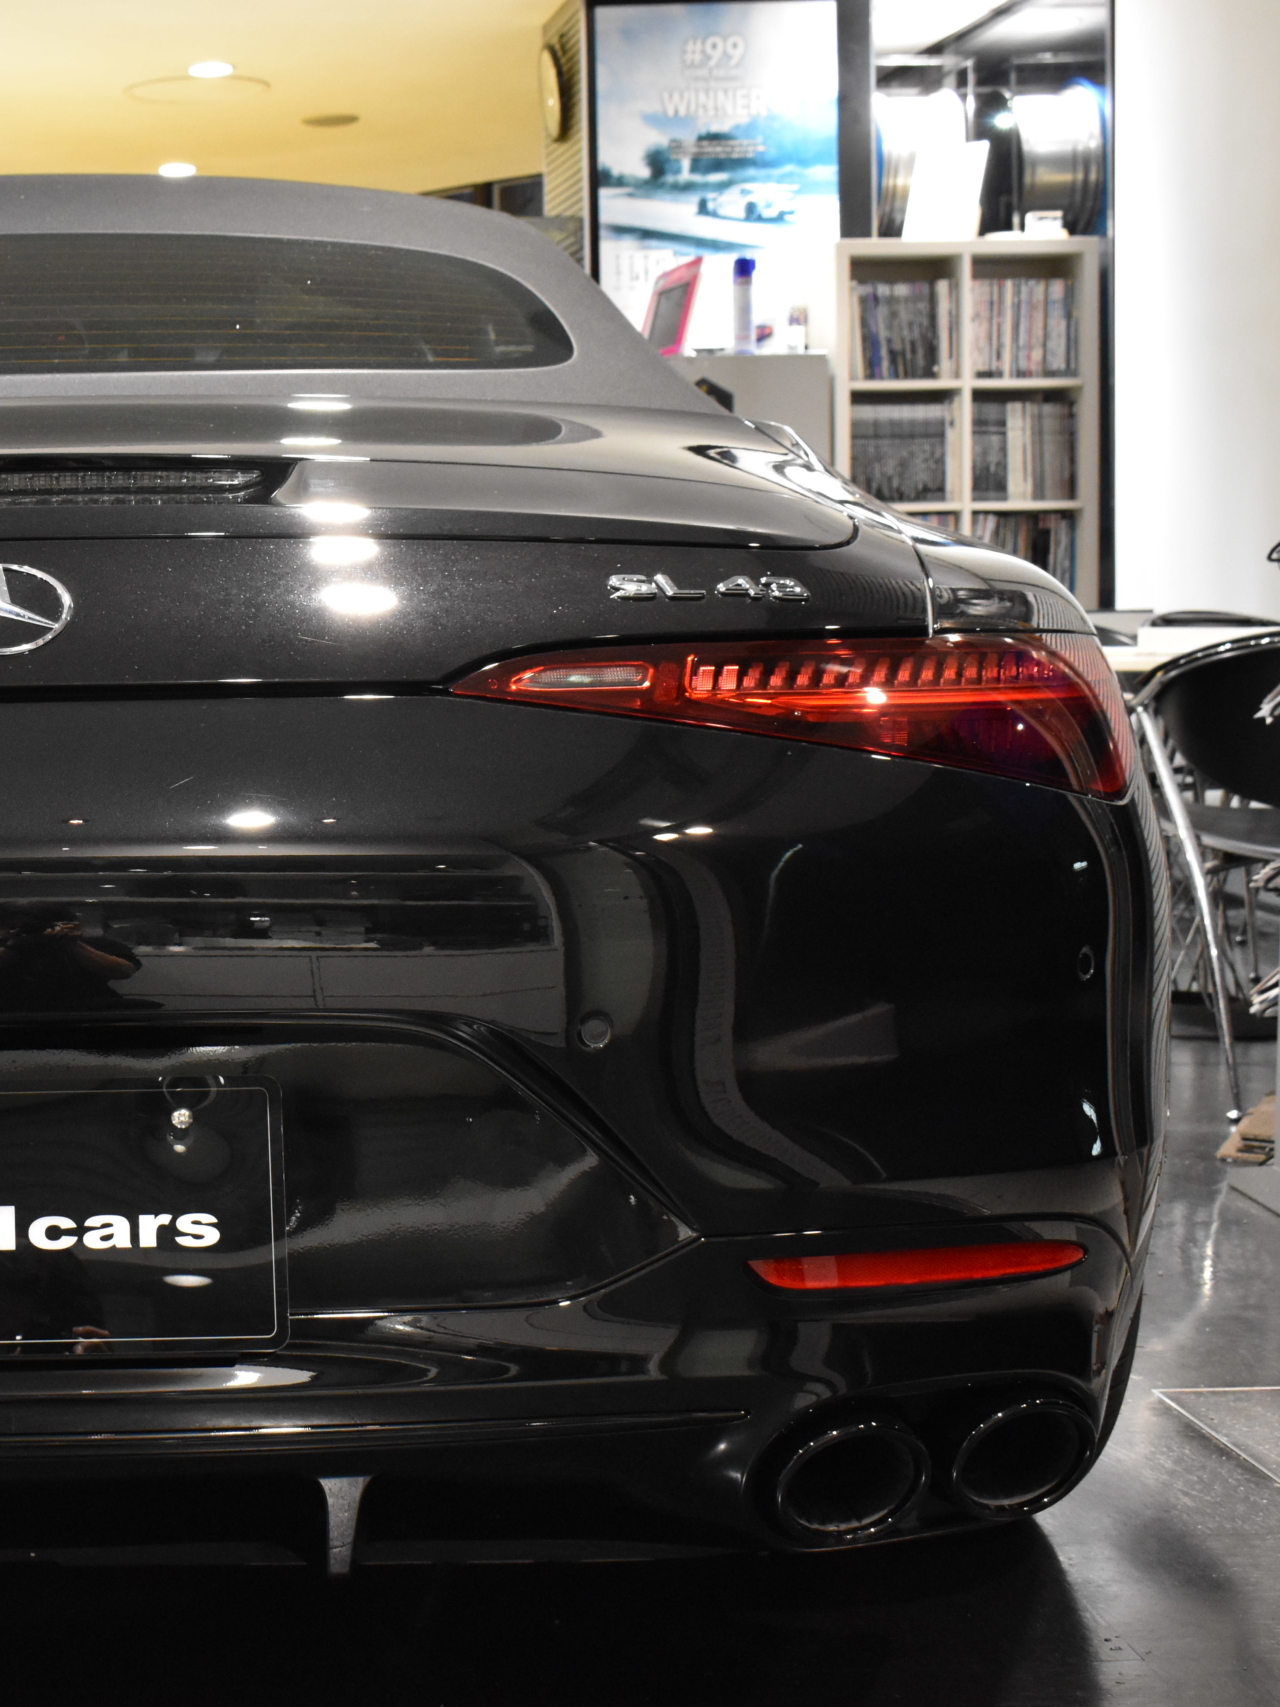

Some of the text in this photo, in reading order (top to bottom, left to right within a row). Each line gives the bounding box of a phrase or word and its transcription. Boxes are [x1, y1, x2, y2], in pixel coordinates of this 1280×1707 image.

[682, 35, 745, 66] #99
[662, 88, 768, 117] WINNER
[607, 573, 811, 601] SL 43
